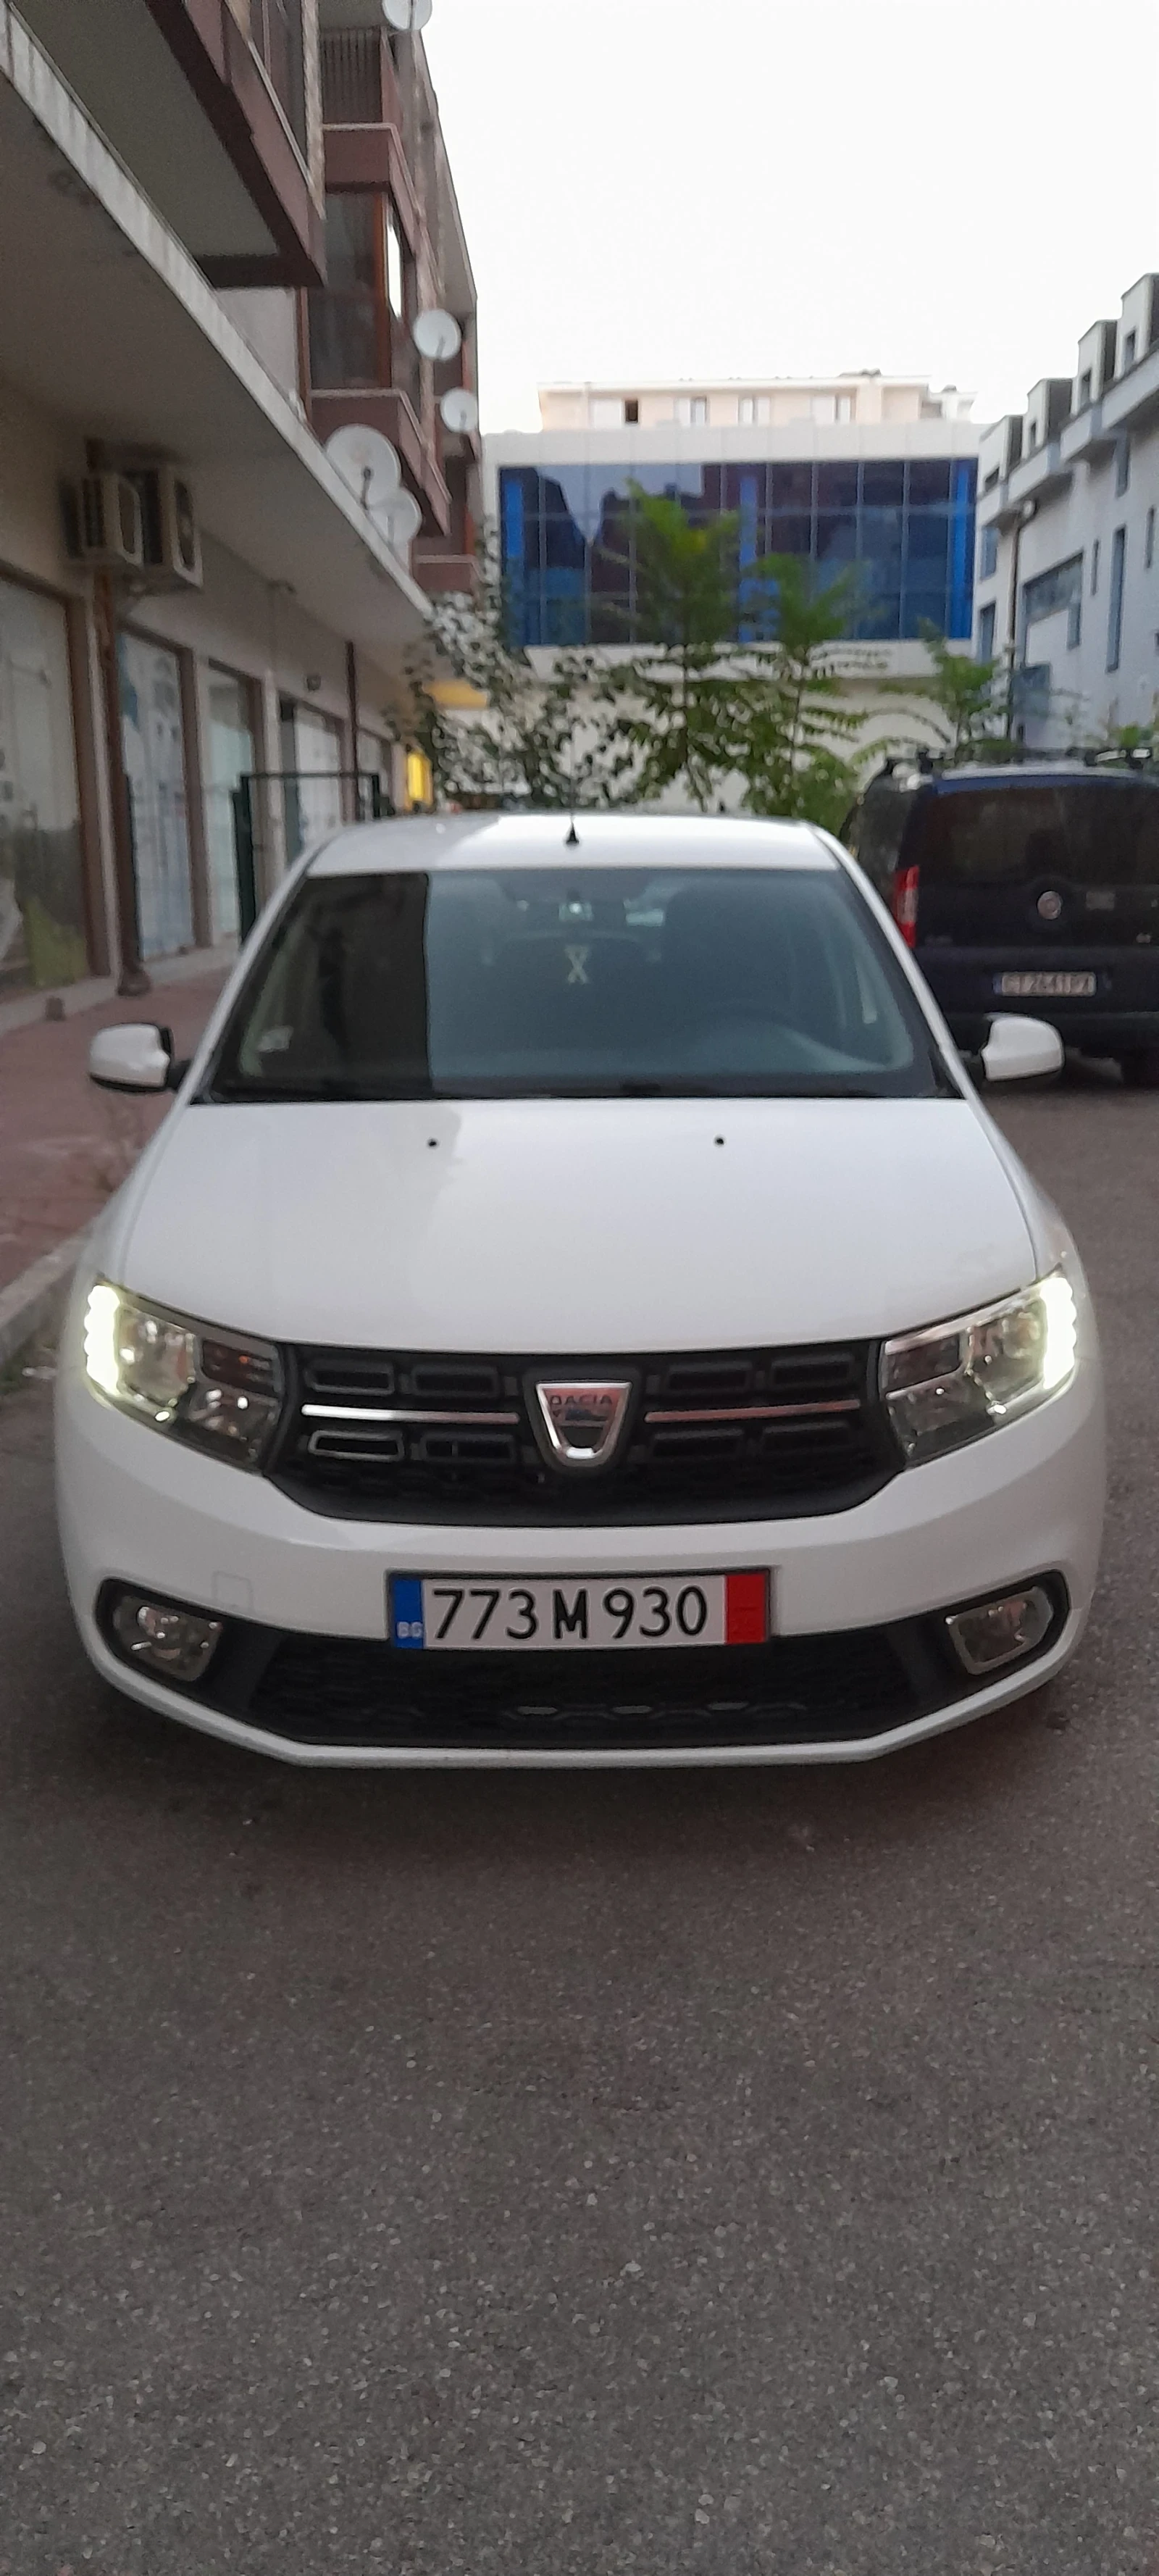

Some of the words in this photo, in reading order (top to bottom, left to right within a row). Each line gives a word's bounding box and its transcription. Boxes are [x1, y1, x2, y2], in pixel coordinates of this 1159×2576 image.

[550, 1394, 613, 1405] DACIA
[432, 1588, 538, 1639] 773
[553, 1588, 587, 1639] M
[603, 1585, 708, 1638] 930
[397, 1621, 423, 1638] BG
